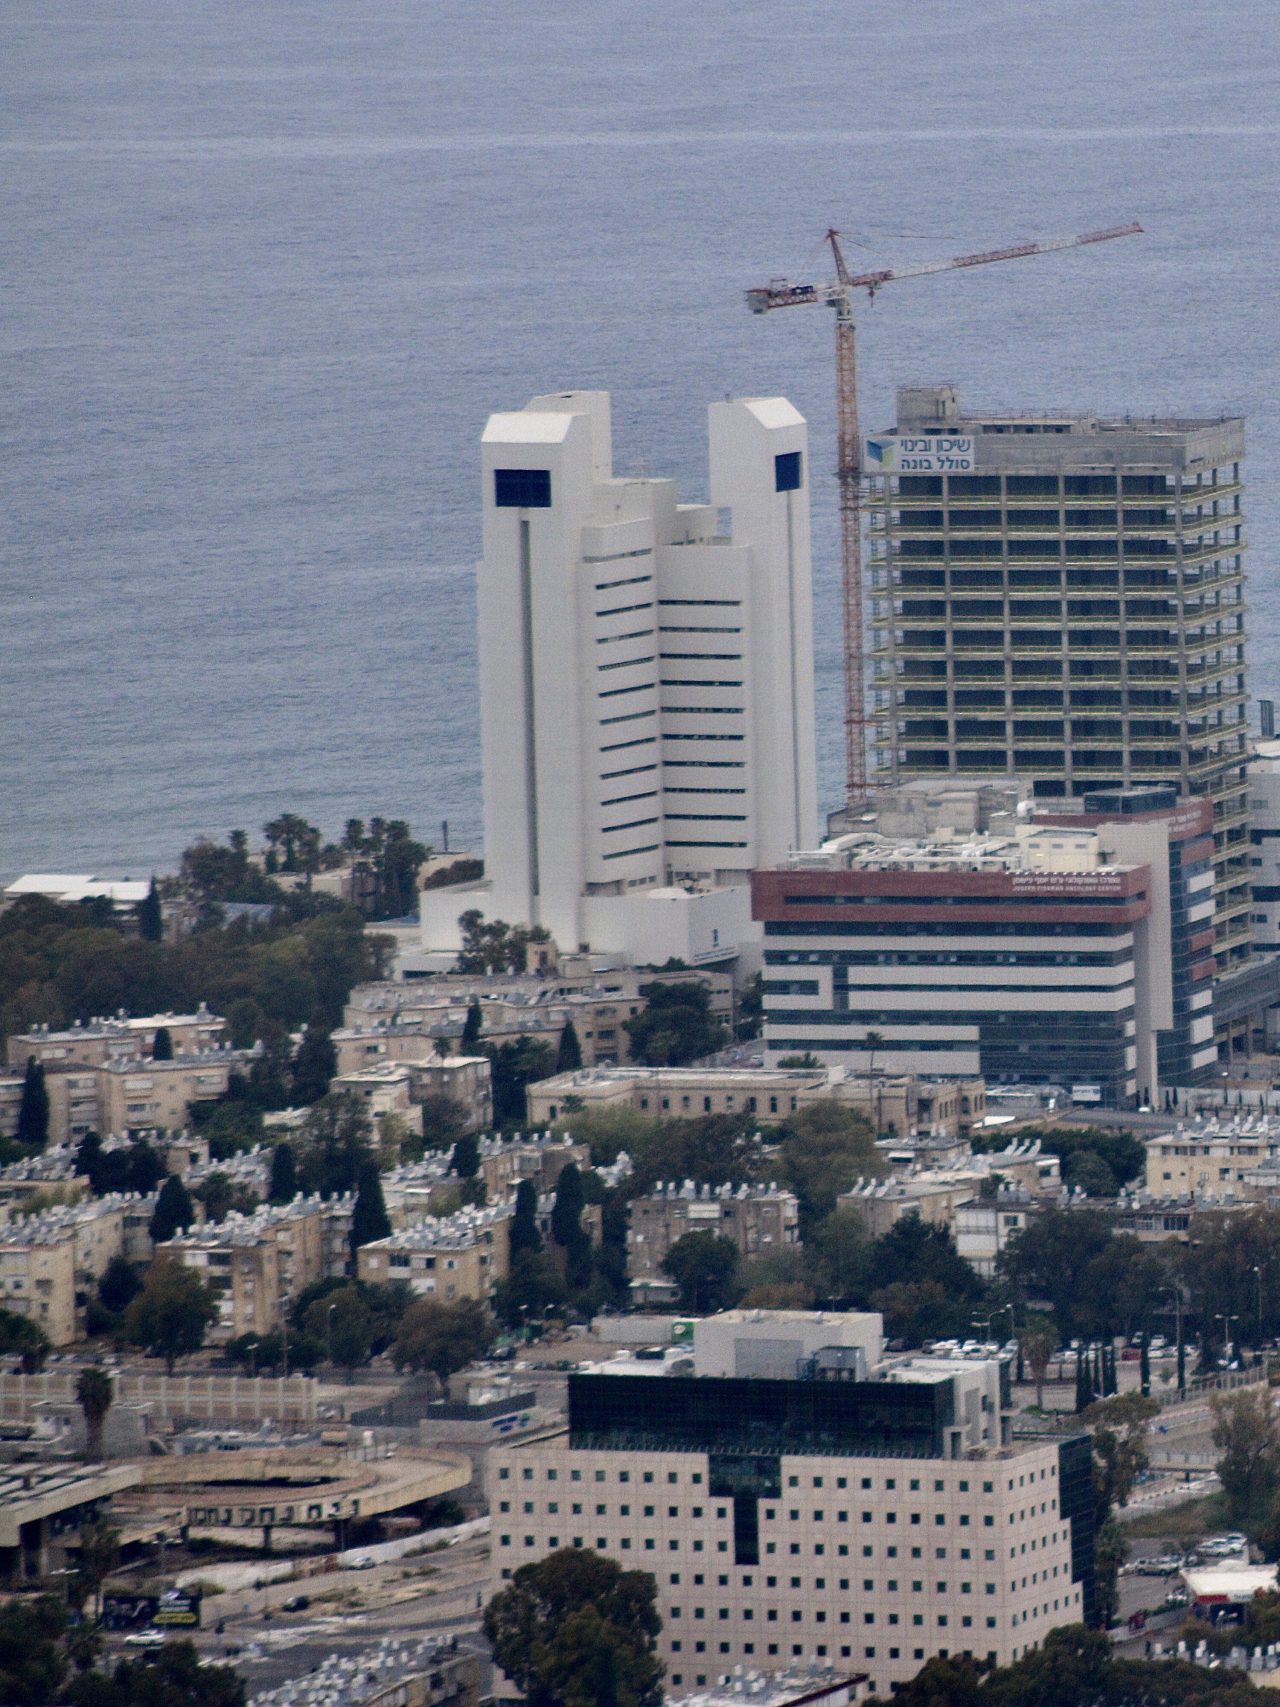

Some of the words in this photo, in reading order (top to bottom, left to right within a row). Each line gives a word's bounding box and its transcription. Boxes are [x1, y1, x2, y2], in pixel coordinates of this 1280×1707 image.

[900, 439, 931, 452] ובינוי
[936, 439, 971, 454] שיכון
[901, 458, 933, 470] בונה
[936, 456, 970, 470] סולל
